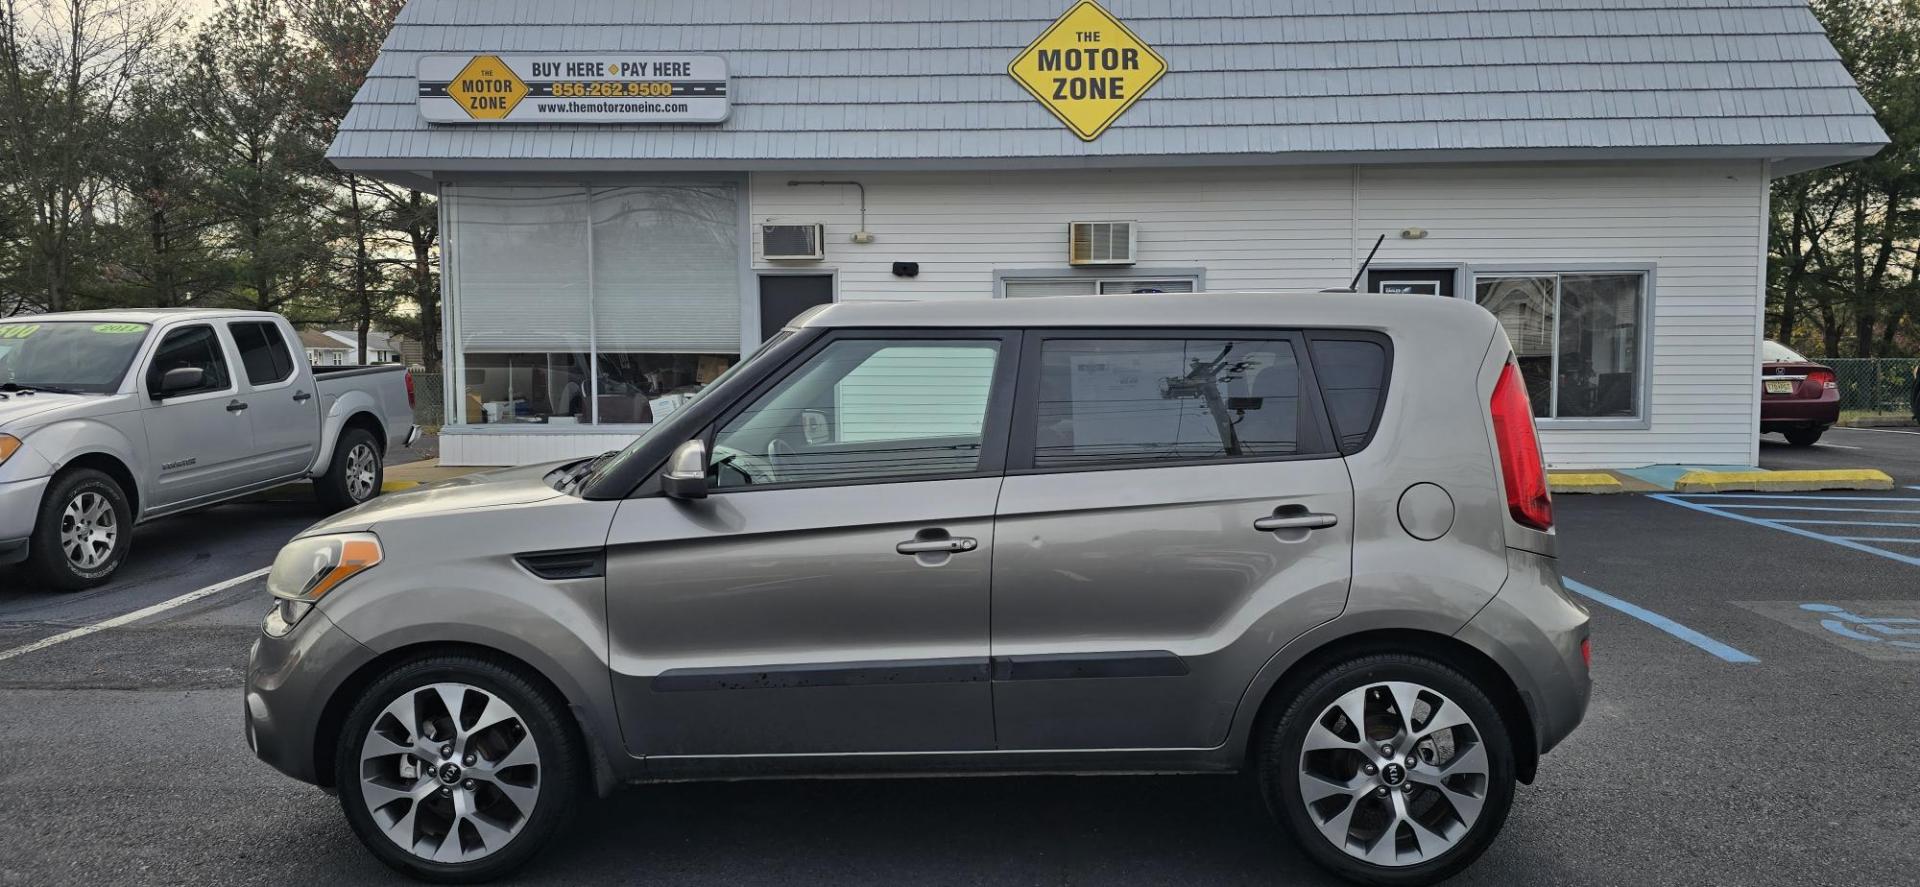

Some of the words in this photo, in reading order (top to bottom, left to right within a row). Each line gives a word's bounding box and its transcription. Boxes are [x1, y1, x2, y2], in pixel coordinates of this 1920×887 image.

[1076, 31, 1101, 42] THE
[1037, 48, 1140, 71] MOTOR
[532, 62, 561, 77] BUY
[566, 62, 604, 77] HERE
[621, 62, 648, 77] PAY
[653, 62, 691, 77] HERE
[462, 79, 513, 93] MOTOR
[551, 81, 673, 97] 856.262.9500
[1052, 77, 1125, 100] ZONE
[470, 96, 507, 110] ZONE
[537, 101, 688, 113] www.themotorzoneinc.com
[1388, 764, 1399, 784] KIA
